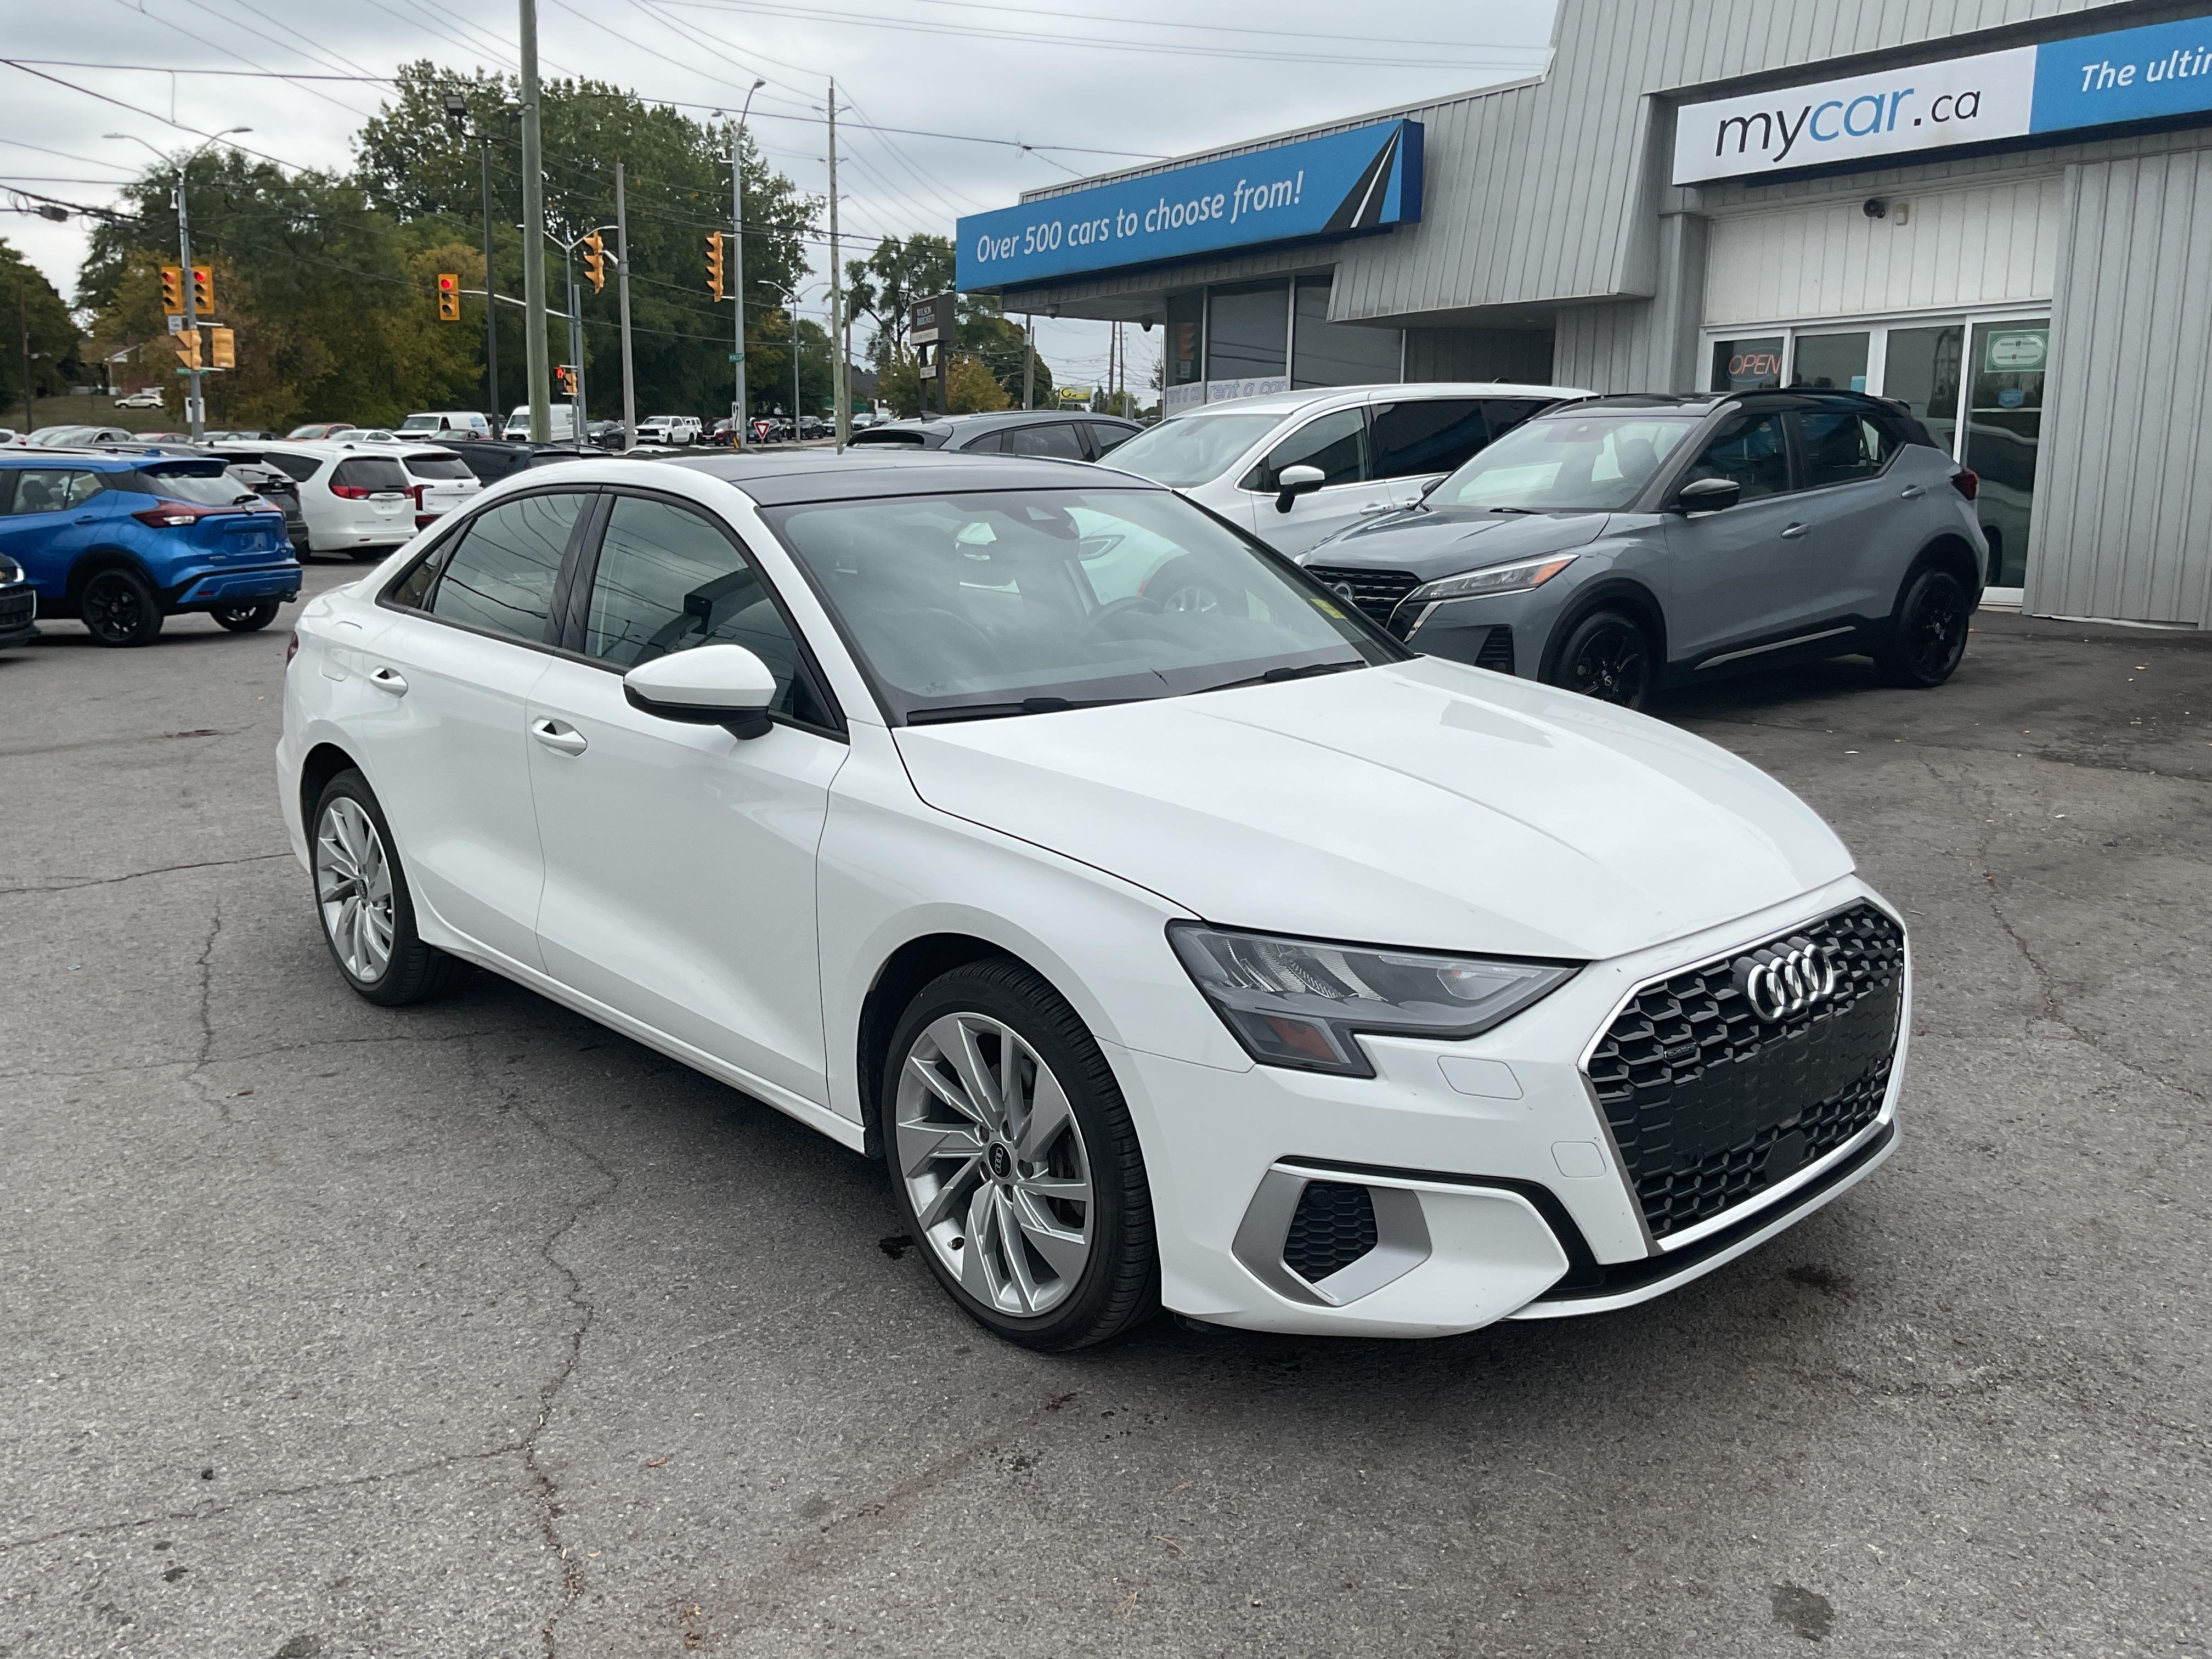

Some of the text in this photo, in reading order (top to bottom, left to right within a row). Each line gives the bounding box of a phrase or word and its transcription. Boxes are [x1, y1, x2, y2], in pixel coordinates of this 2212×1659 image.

[2081, 61, 2136, 92] The
[977, 170, 1304, 263] Over 500 cars to choose from!
[1729, 354, 1782, 375] OPEN
[1207, 380, 1240, 399] rent
[1243, 382, 1255, 398] a
